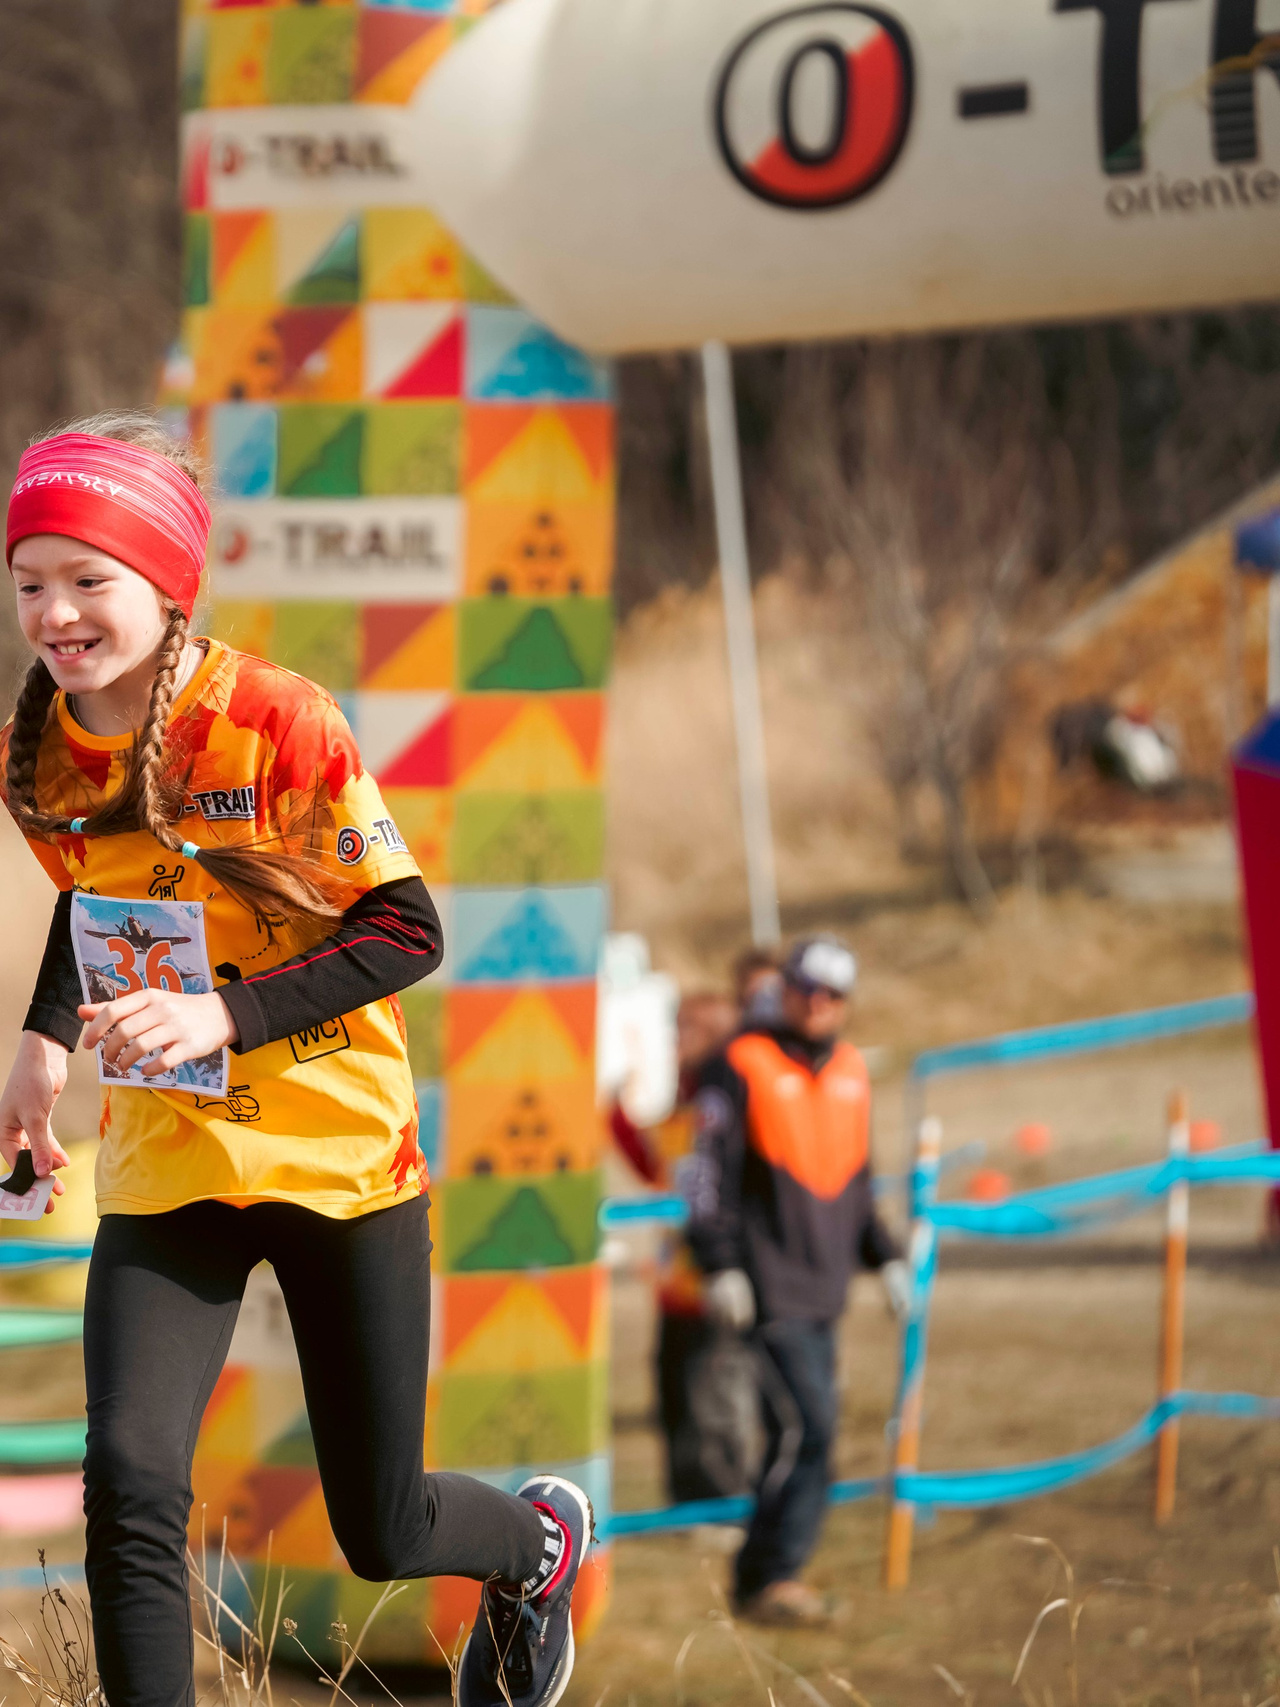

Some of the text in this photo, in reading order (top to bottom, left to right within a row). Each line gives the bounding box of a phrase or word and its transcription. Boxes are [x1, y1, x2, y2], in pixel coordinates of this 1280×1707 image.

[214, 133, 406, 181] O-TRAIL
[215, 517, 446, 571] O-TRAIL
[105, 937, 184, 1000] 36
[296, 1017, 339, 1048] WC
